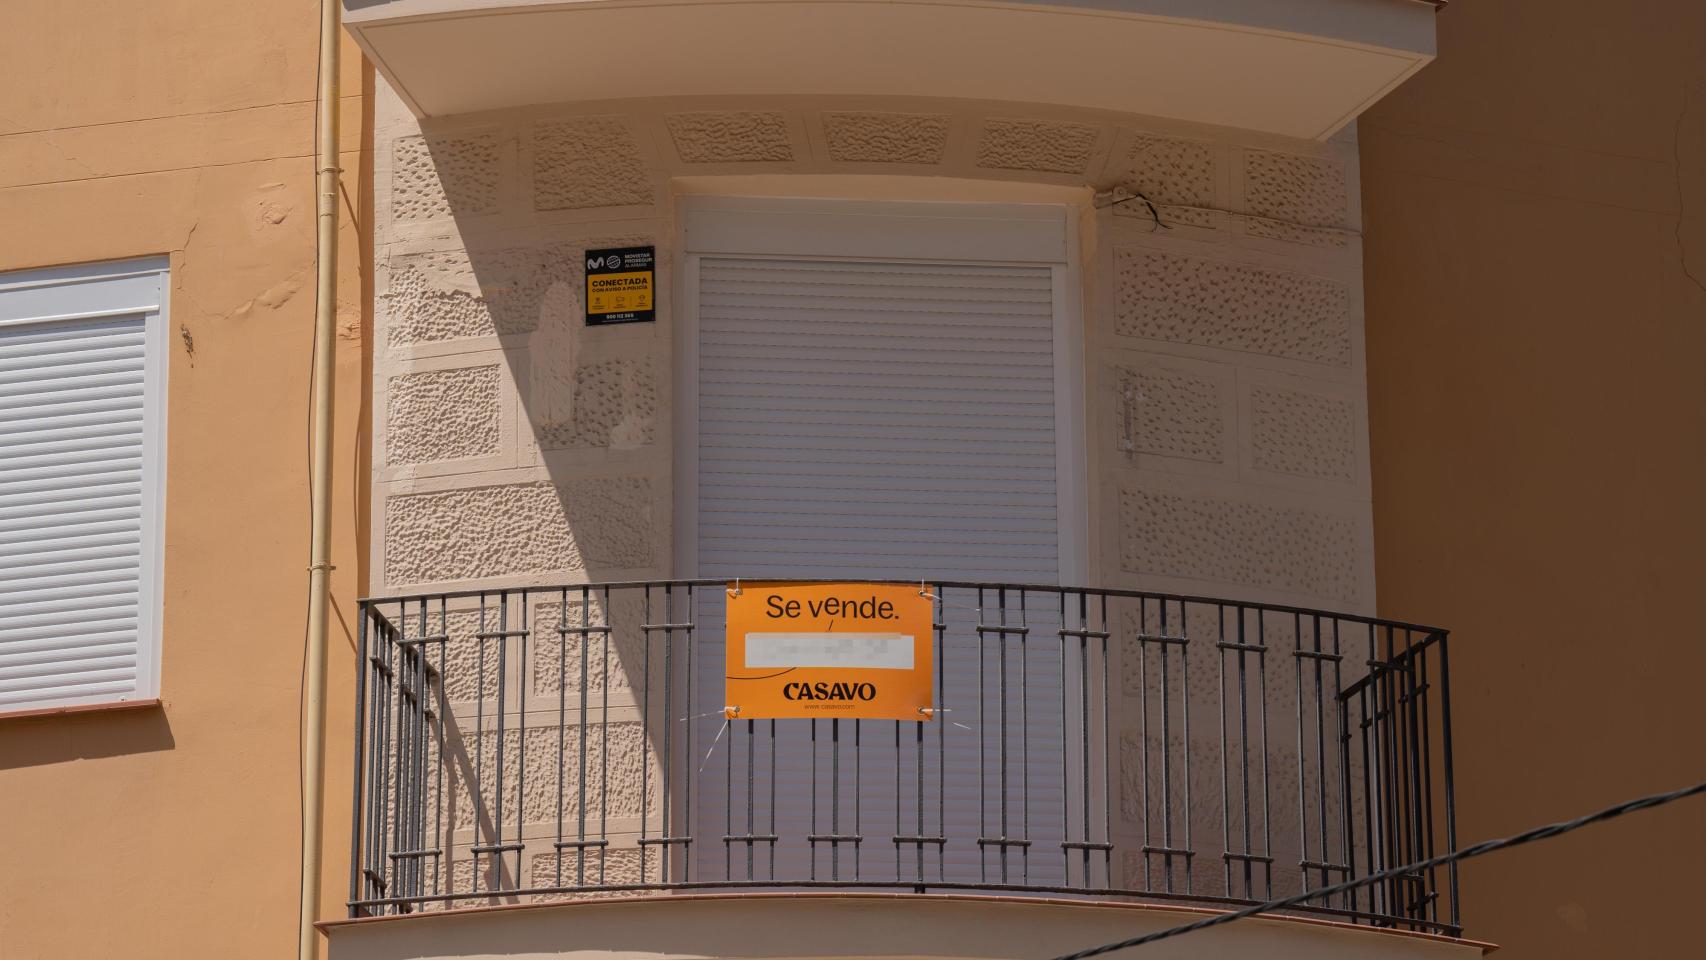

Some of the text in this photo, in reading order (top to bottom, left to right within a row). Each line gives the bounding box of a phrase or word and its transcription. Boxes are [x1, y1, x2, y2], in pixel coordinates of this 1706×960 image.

[592, 277, 648, 287] CONECTADA
[766, 595, 899, 619] Se vende.
[783, 682, 876, 701] CASAVO
